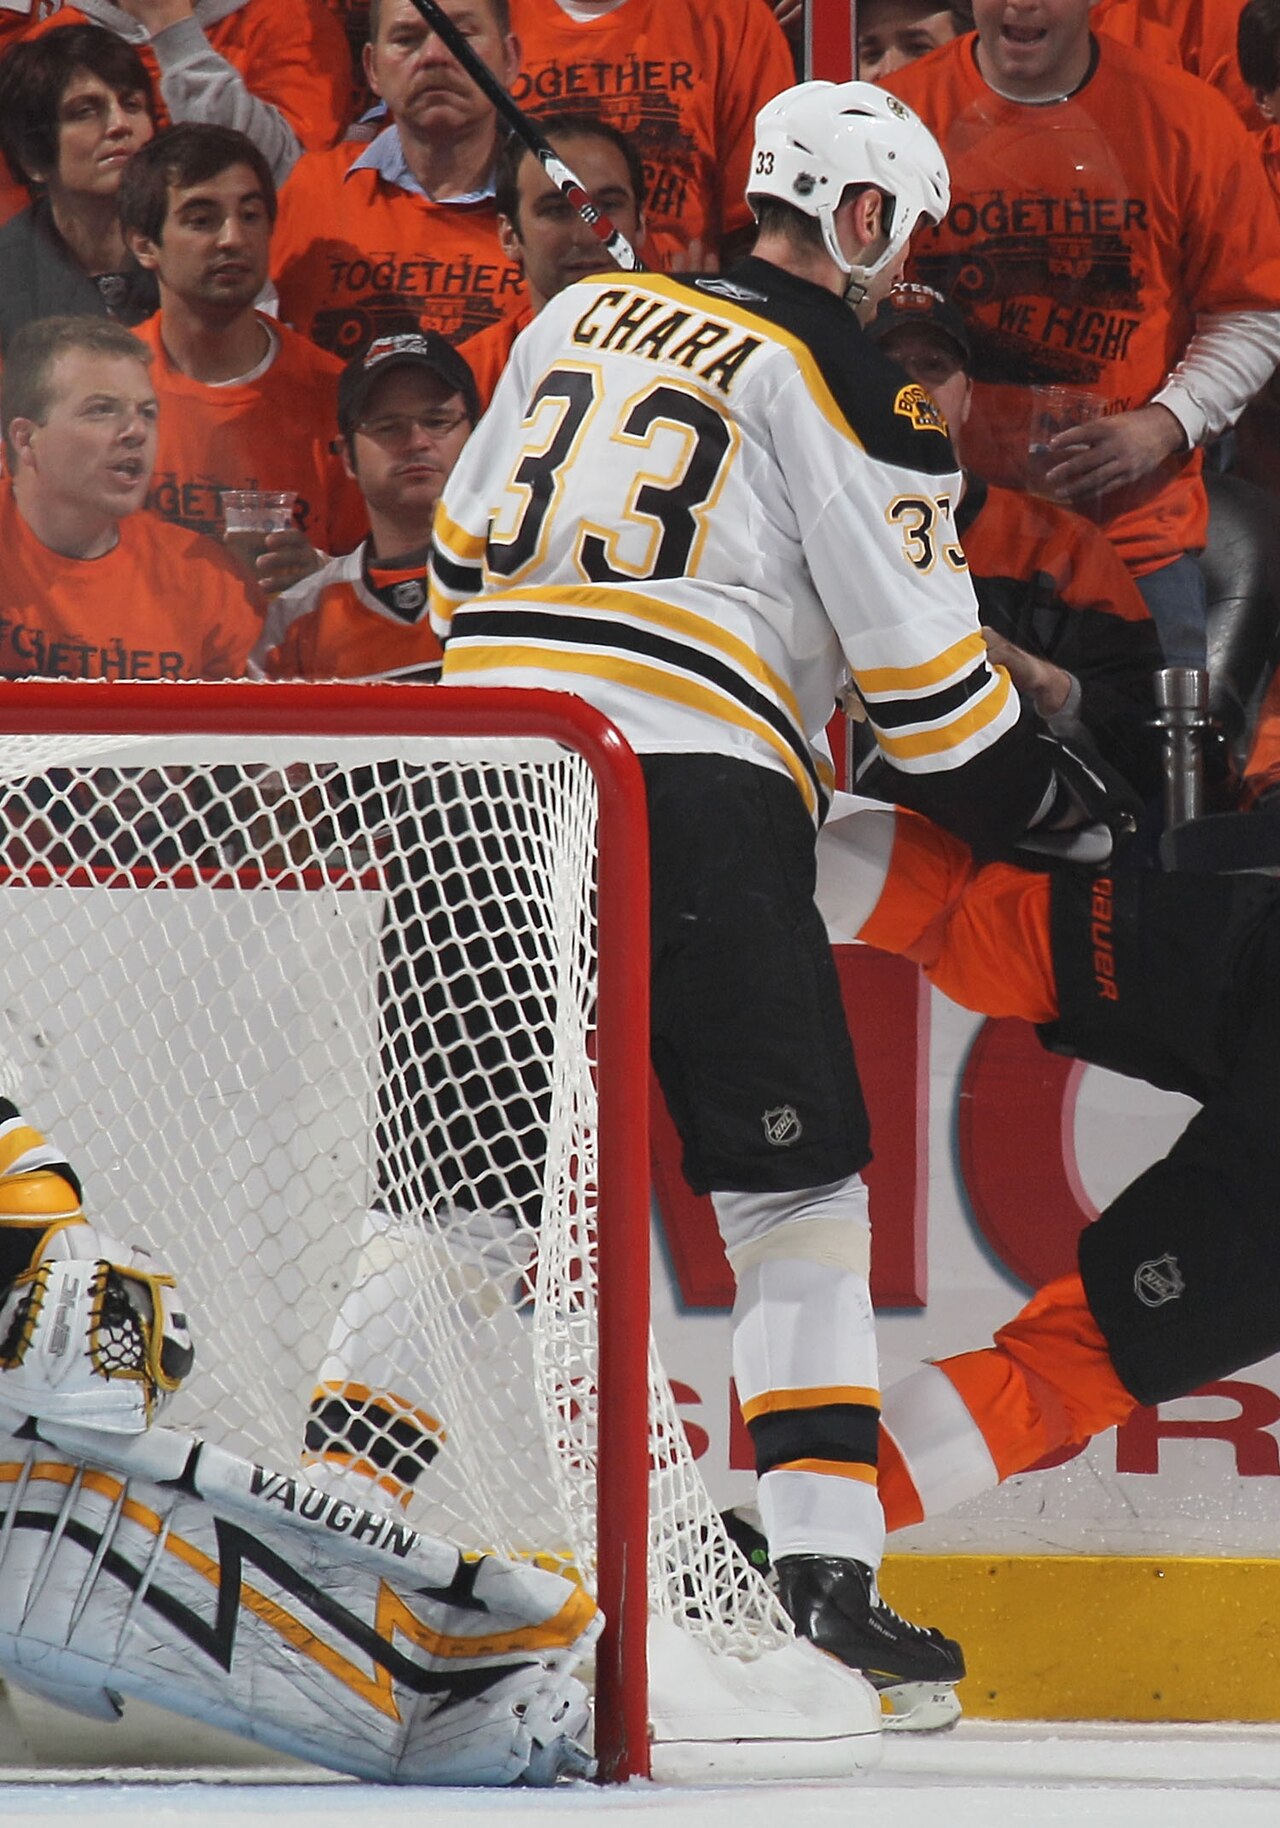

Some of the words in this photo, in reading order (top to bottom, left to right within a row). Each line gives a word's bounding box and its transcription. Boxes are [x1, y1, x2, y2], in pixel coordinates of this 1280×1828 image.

[508, 61, 695, 101] OGETHER
[755, 151, 774, 174] 33
[330, 260, 525, 296] TOGETHER
[998, 303, 1038, 335] WE
[571, 289, 766, 397] CHARA
[483, 358, 742, 586] 33
[249, 1463, 422, 1558] VAUGHN
